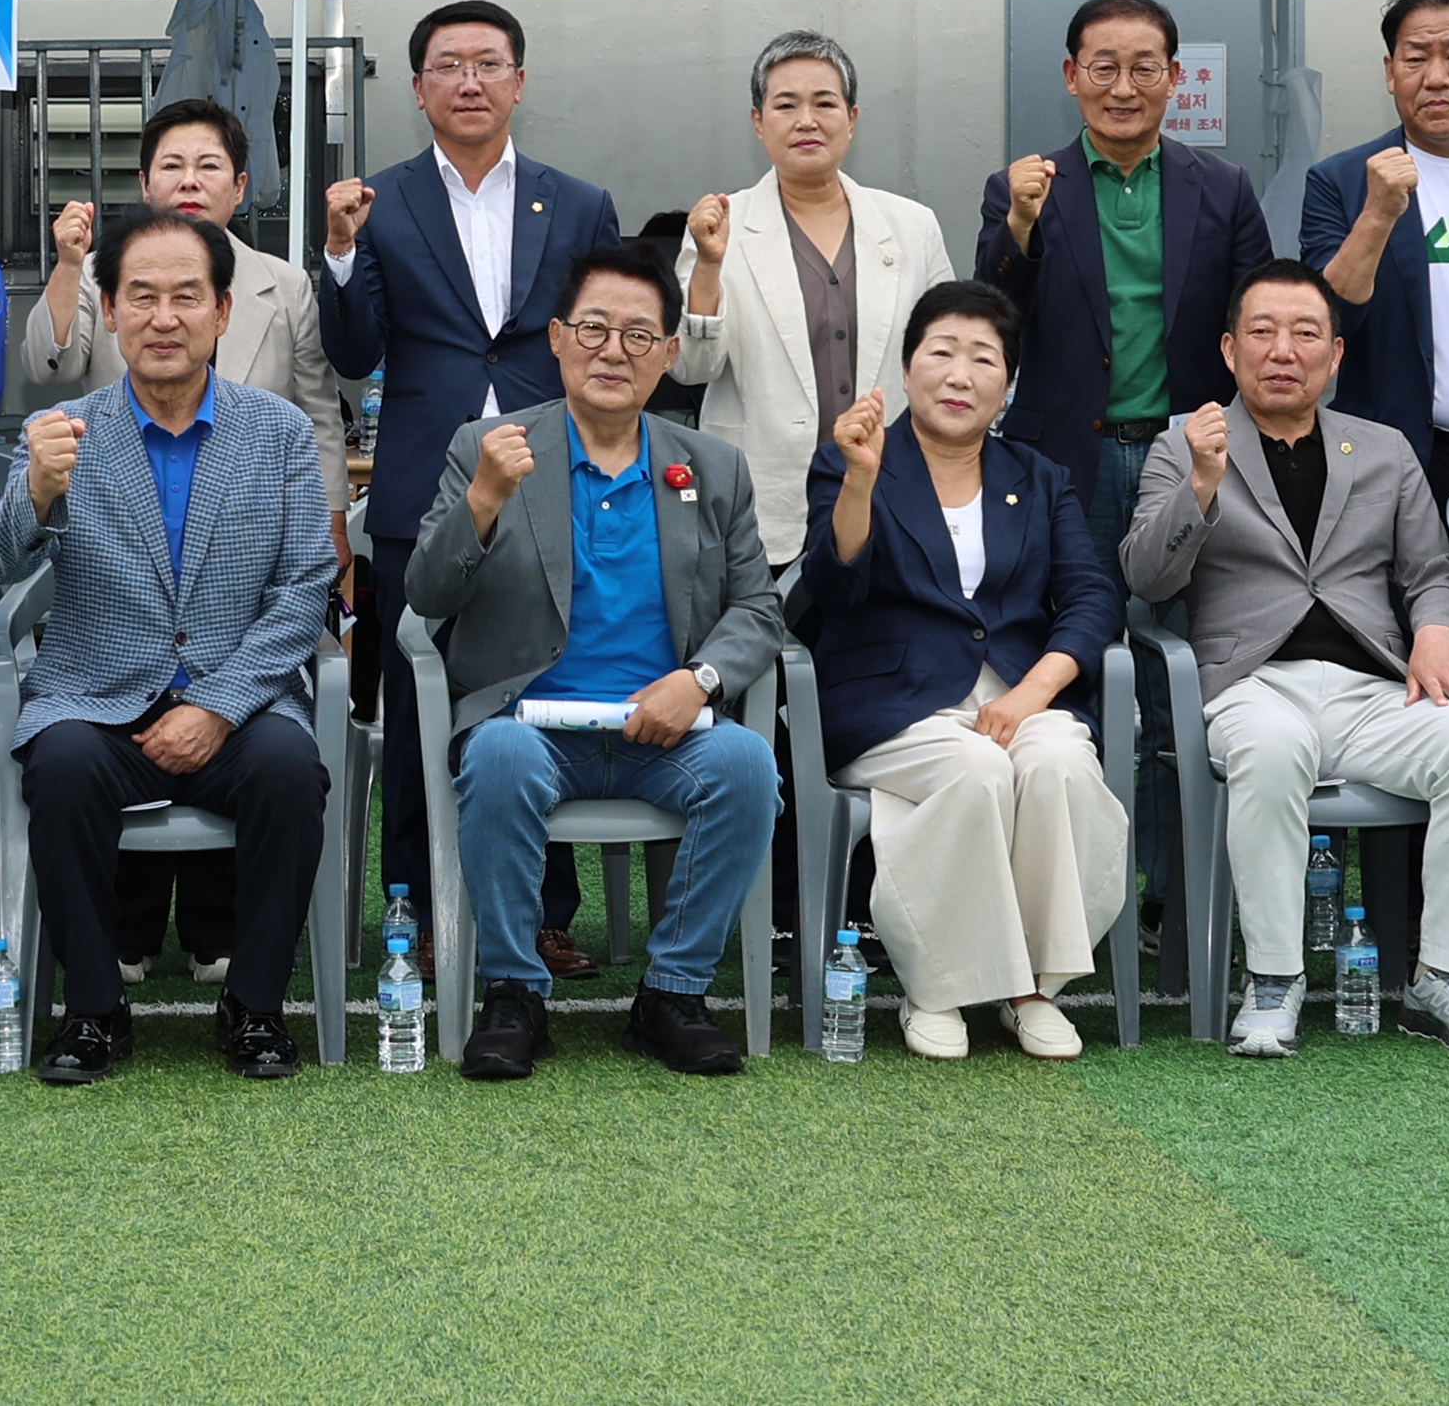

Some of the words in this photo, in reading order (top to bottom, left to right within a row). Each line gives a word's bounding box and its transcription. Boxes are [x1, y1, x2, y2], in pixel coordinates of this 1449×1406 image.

[1197, 68, 1212, 84] 후
[1176, 93, 1207, 109] 철저
[1198, 118, 1222, 131] 조치
